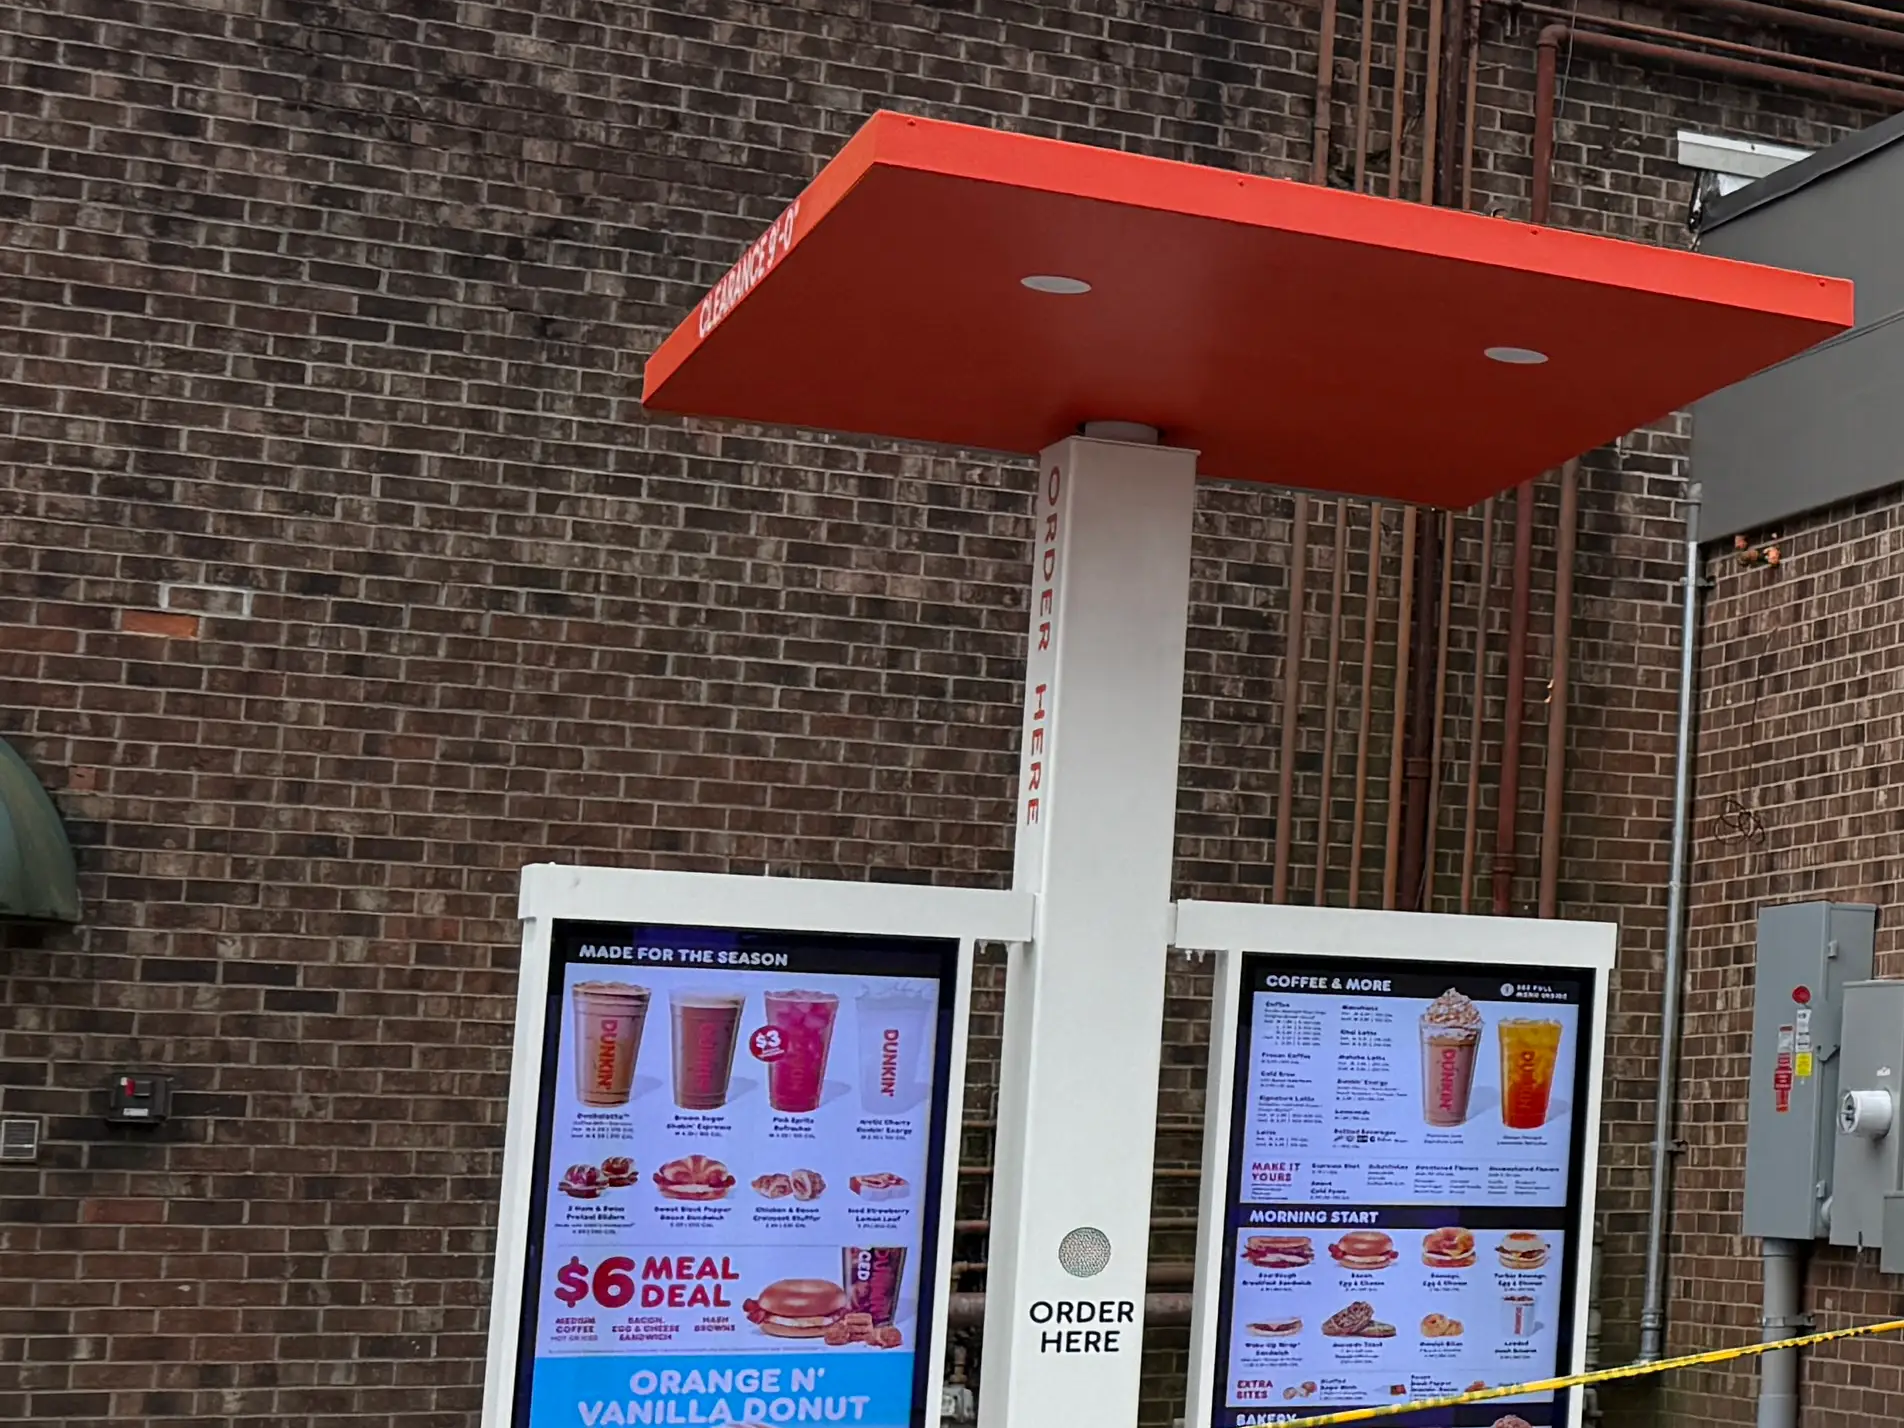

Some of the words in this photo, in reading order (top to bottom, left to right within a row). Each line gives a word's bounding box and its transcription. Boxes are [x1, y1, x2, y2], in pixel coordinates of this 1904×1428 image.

[700, 235, 768, 338] CLEARANCE
[1038, 466, 1060, 652] ORDER
[1026, 683, 1047, 827] HERE
[579, 944, 633, 961] MADE
[638, 946, 674, 962] FOR
[678, 948, 713, 963] THE
[717, 951, 788, 967] SEASON
[1266, 975, 1327, 990] COFFEE
[1331, 977, 1343, 990] &
[1347, 978, 1391, 992] MORE
[755, 1031, 781, 1048] $3
[597, 1020, 617, 1090] DUNKIN'
[880, 1029, 899, 1097] DUNKIN'
[1252, 1163, 1285, 1171] MAKE
[1289, 1163, 1300, 1171] IT
[1252, 1173, 1291, 1181] YOURS
[1250, 1210, 1326, 1223] MORNING
[1331, 1211, 1378, 1223] START
[554, 1256, 635, 1308] $6
[642, 1256, 739, 1280] MEAL
[641, 1284, 731, 1308] DEAL
[1030, 1301, 1134, 1323] ORDER
[556, 1325, 594, 1333] COFFEE
[1041, 1331, 1120, 1353] HERE
[630, 1369, 781, 1396] ORANGE
[790, 1368, 825, 1392] N'
[1237, 1380, 1273, 1388] EXTRA
[1237, 1391, 1267, 1399] BITES
[578, 1398, 733, 1427] VANILLA
[743, 1396, 870, 1424] DONUT
